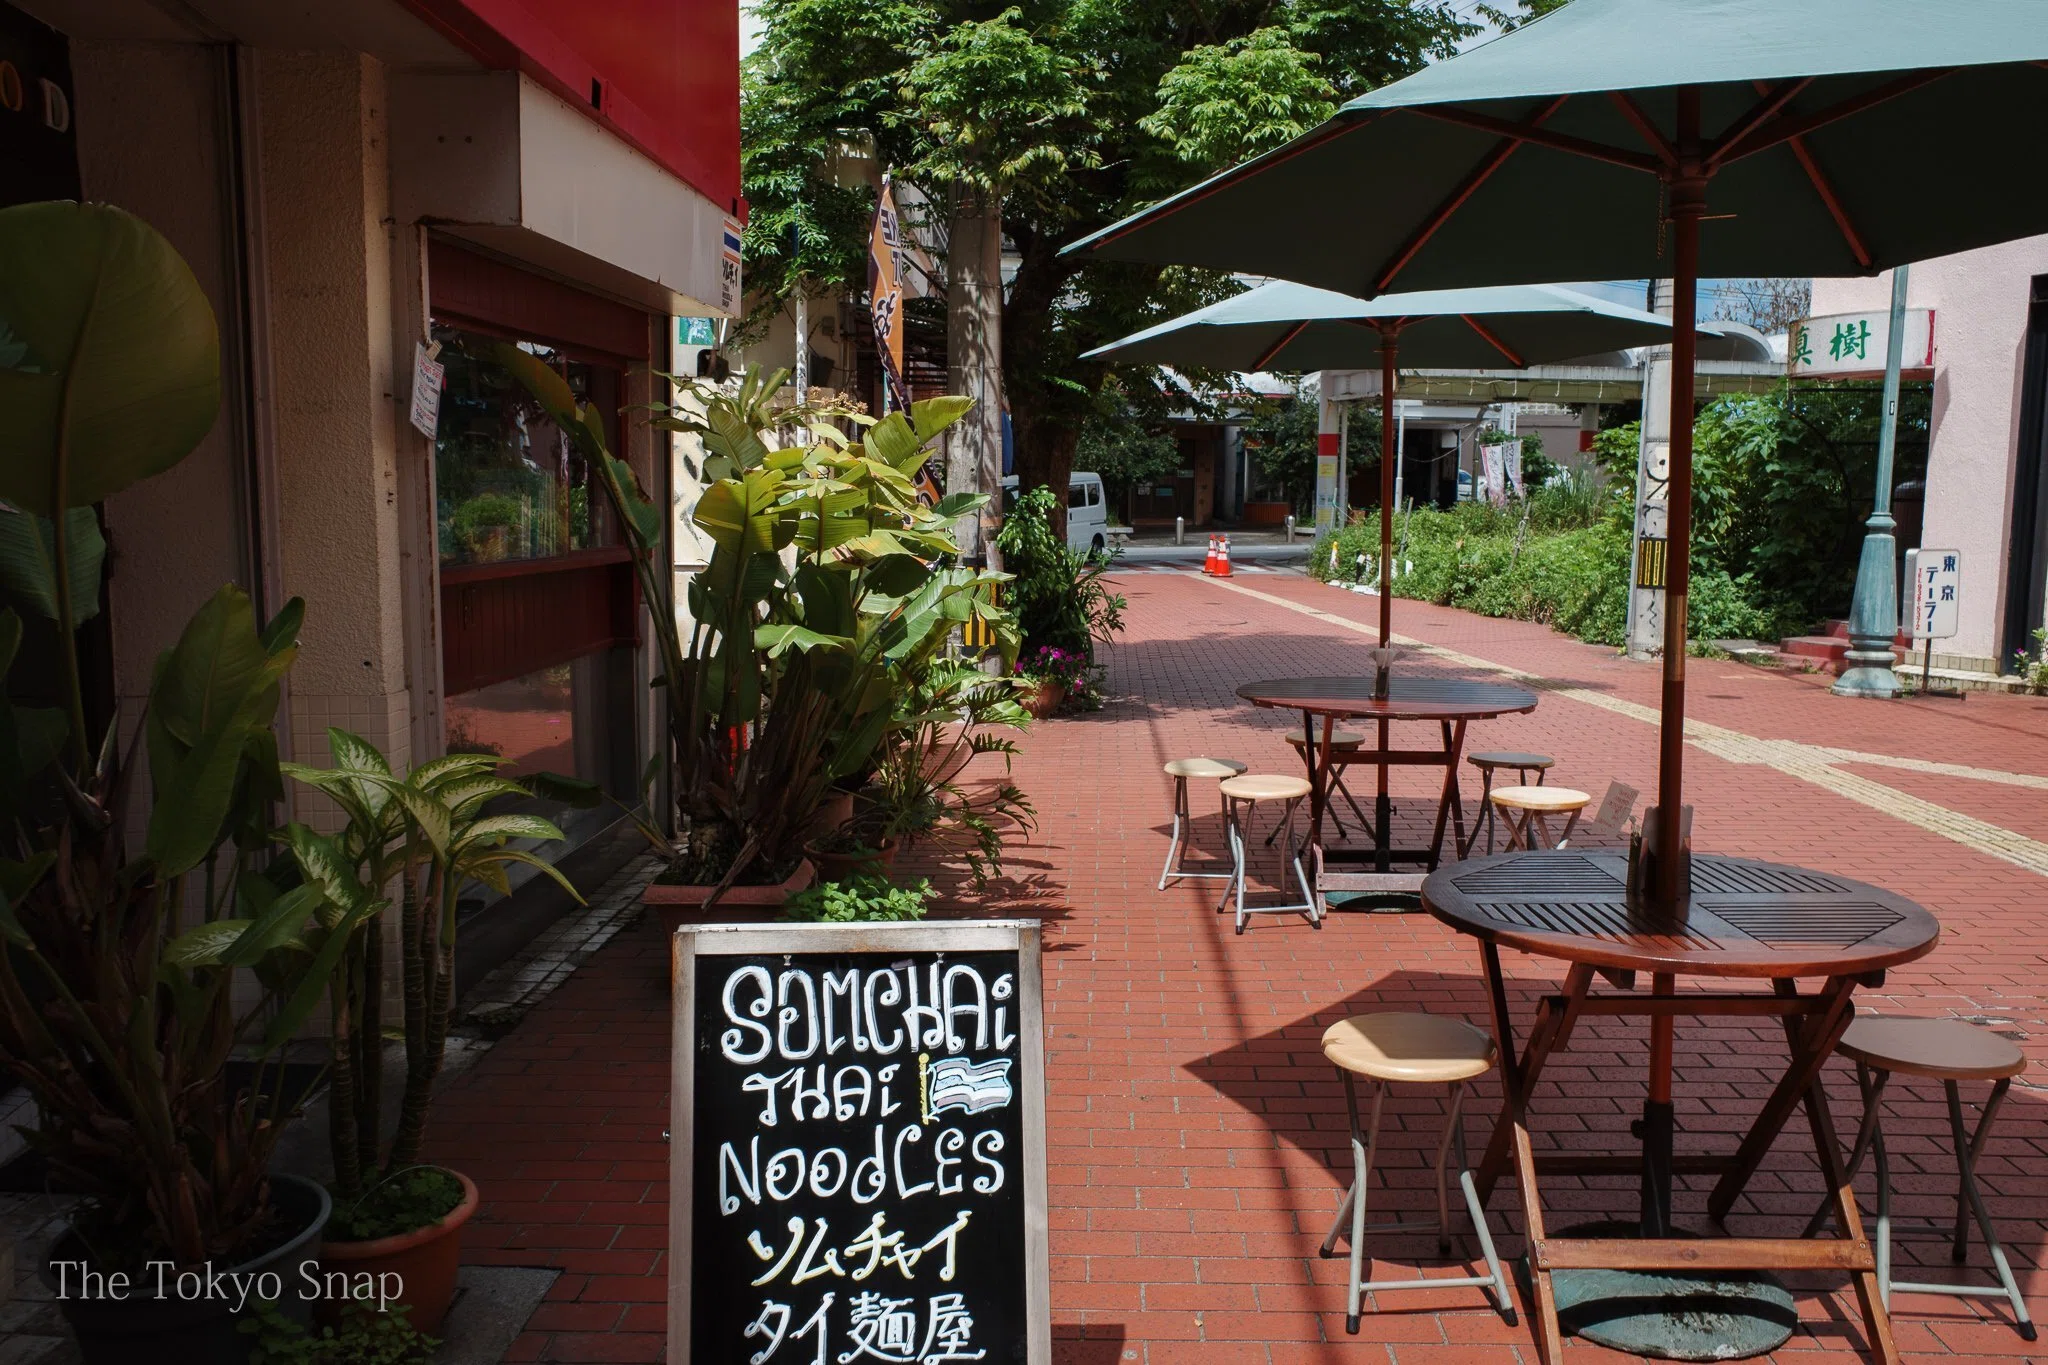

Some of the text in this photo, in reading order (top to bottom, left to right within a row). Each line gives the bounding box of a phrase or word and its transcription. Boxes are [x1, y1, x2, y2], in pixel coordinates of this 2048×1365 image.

[1925, 567, 1938, 632] テーラー
[1941, 556, 1956, 601] 東京
[747, 1211, 972, 1286] ソムチャイ
